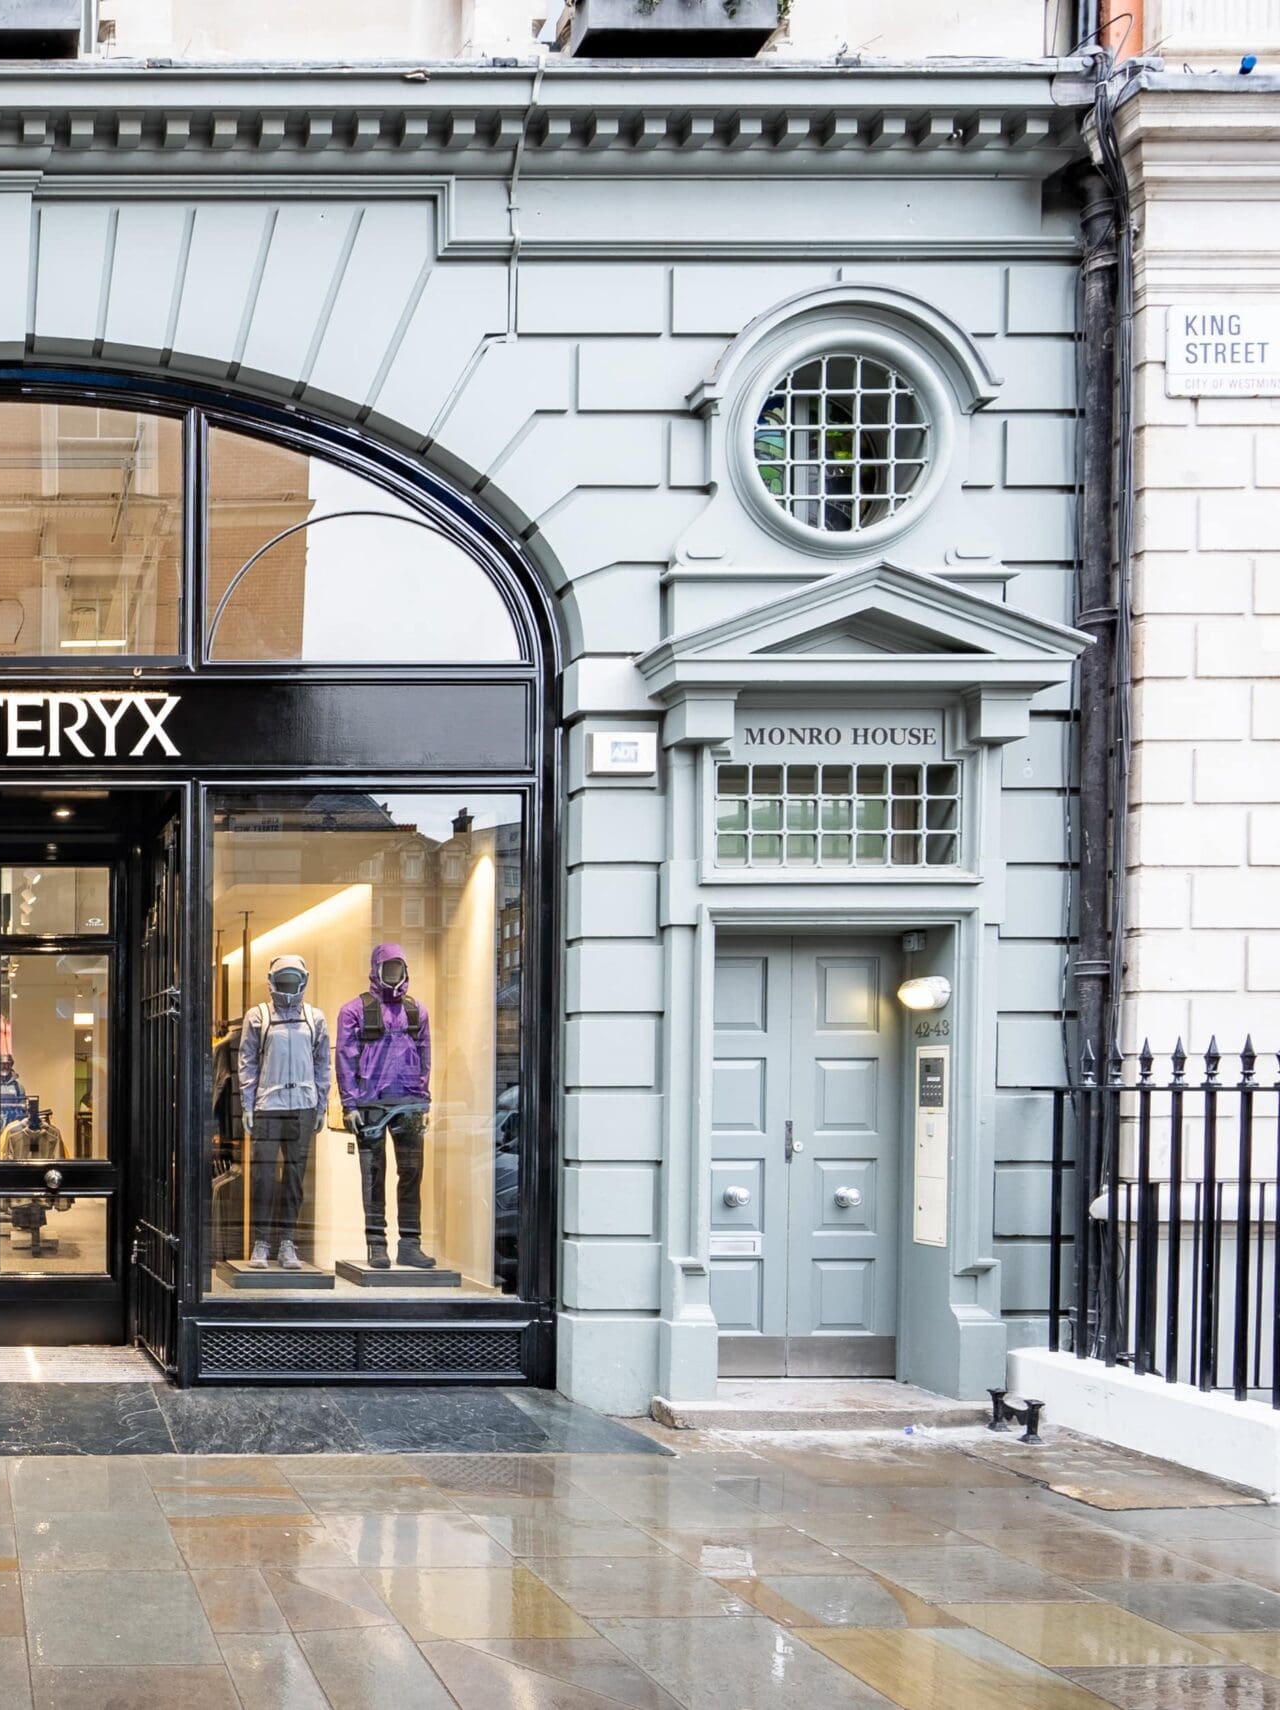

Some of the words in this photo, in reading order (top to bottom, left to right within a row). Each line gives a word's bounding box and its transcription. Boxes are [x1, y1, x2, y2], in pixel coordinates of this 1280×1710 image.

[1185, 314, 1241, 336] KING
[1185, 342, 1269, 364] STREET
[1185, 378, 1208, 389] CITY
[1212, 378, 1224, 389] OF
[744, 727, 842, 746] MONRO
[851, 727, 937, 746] HOUSE
[610, 744, 639, 761] ADT
[915, 1019, 949, 1038] 42-43
